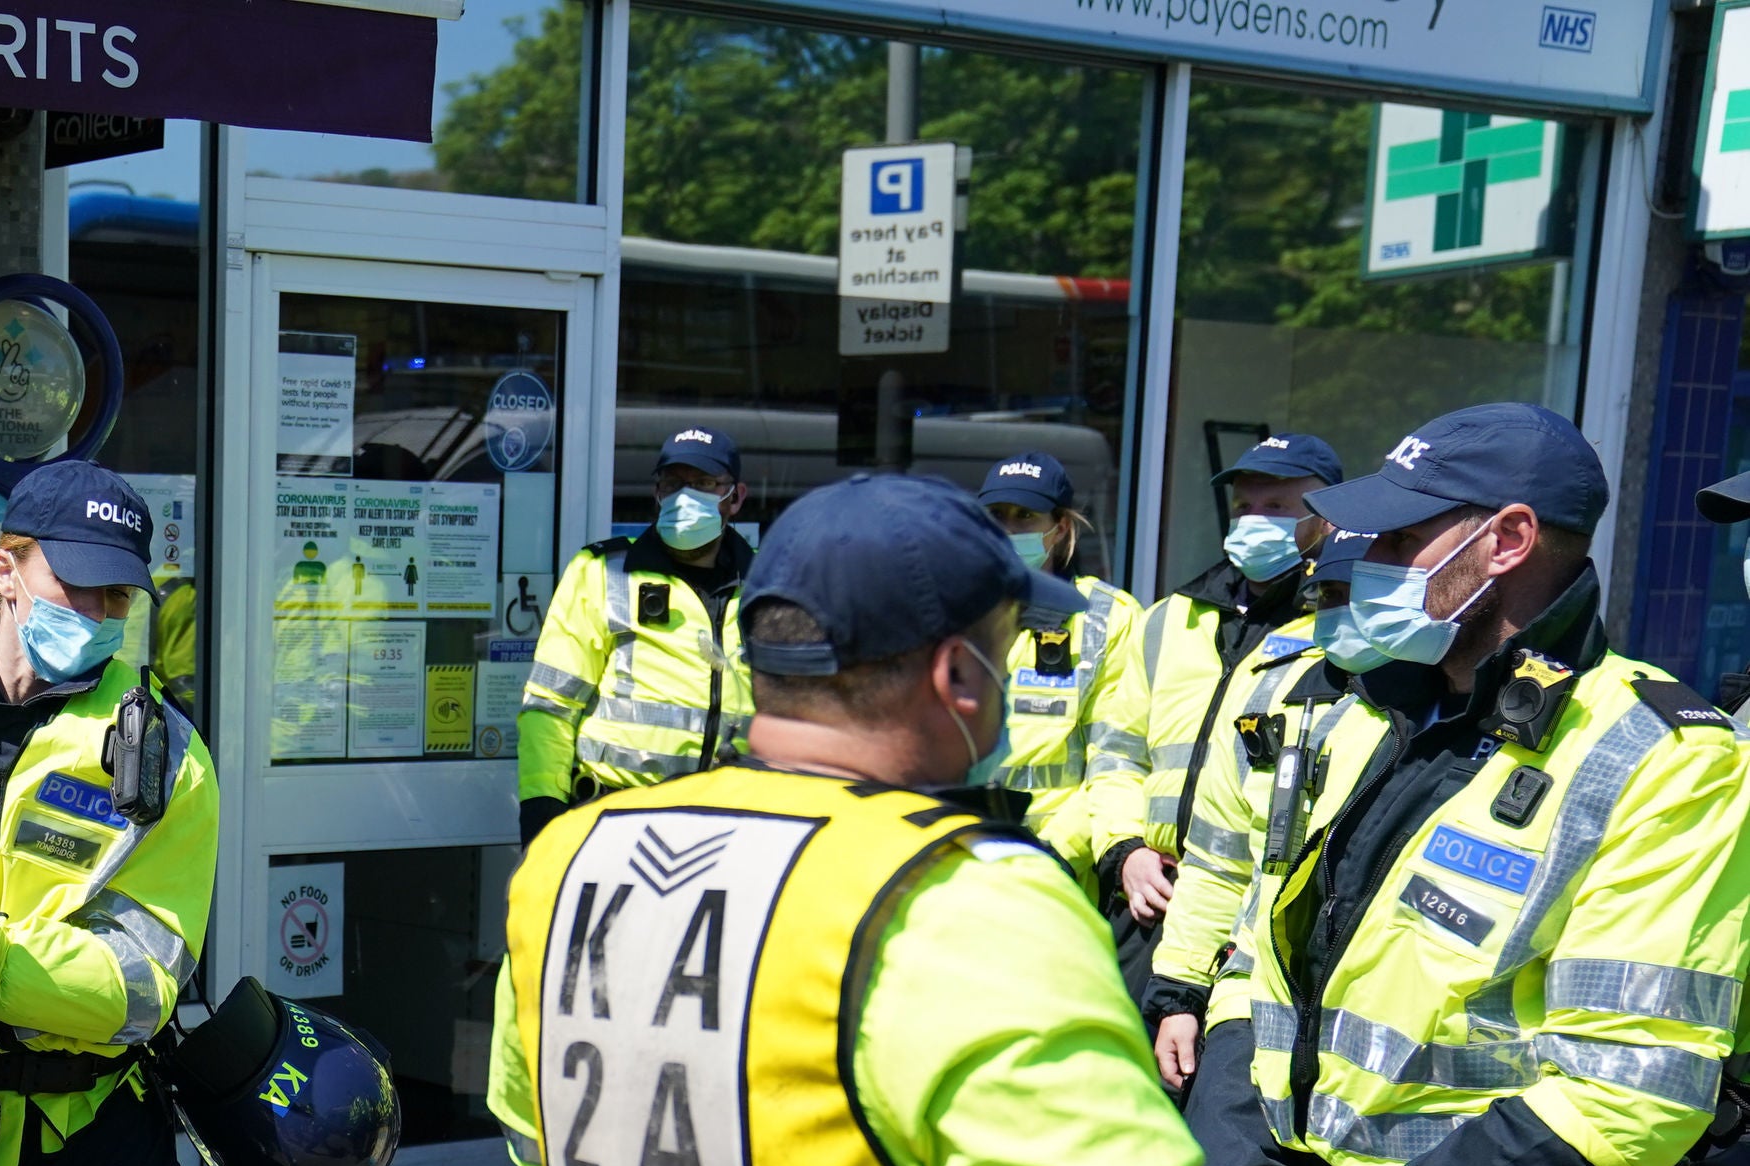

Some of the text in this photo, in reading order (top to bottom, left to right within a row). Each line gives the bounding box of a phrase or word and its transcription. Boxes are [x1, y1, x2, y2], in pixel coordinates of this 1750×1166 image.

[1076, 0, 1389, 49] w.paydens.com
[1544, 14, 1591, 48] NHS
[301, 389, 311, 398] for
[313, 390, 338, 400] people
[492, 392, 548, 412] CLOSED
[674, 429, 713, 444] POLICE
[999, 462, 1043, 479] POLICE
[277, 493, 347, 505] CORONAVIRUS
[354, 497, 421, 509] CORONAVIRUS
[429, 504, 480, 513] CORONAVIRUS
[85, 500, 142, 533] POLICE
[291, 505, 308, 518] ALERT
[333, 507, 346, 519] SAFE
[373, 648, 403, 661] £9.35
[43, 777, 124, 822] POLIC
[36, 840, 78, 860] TONBRIDGE
[43, 832, 76, 850] 14389
[1431, 830, 1529, 885] POLICE
[280, 884, 330, 910] NO FOOD
[1421, 889, 1468, 927] 12616
[279, 953, 331, 978] OR DRINK
[257, 1060, 309, 1108] KA
